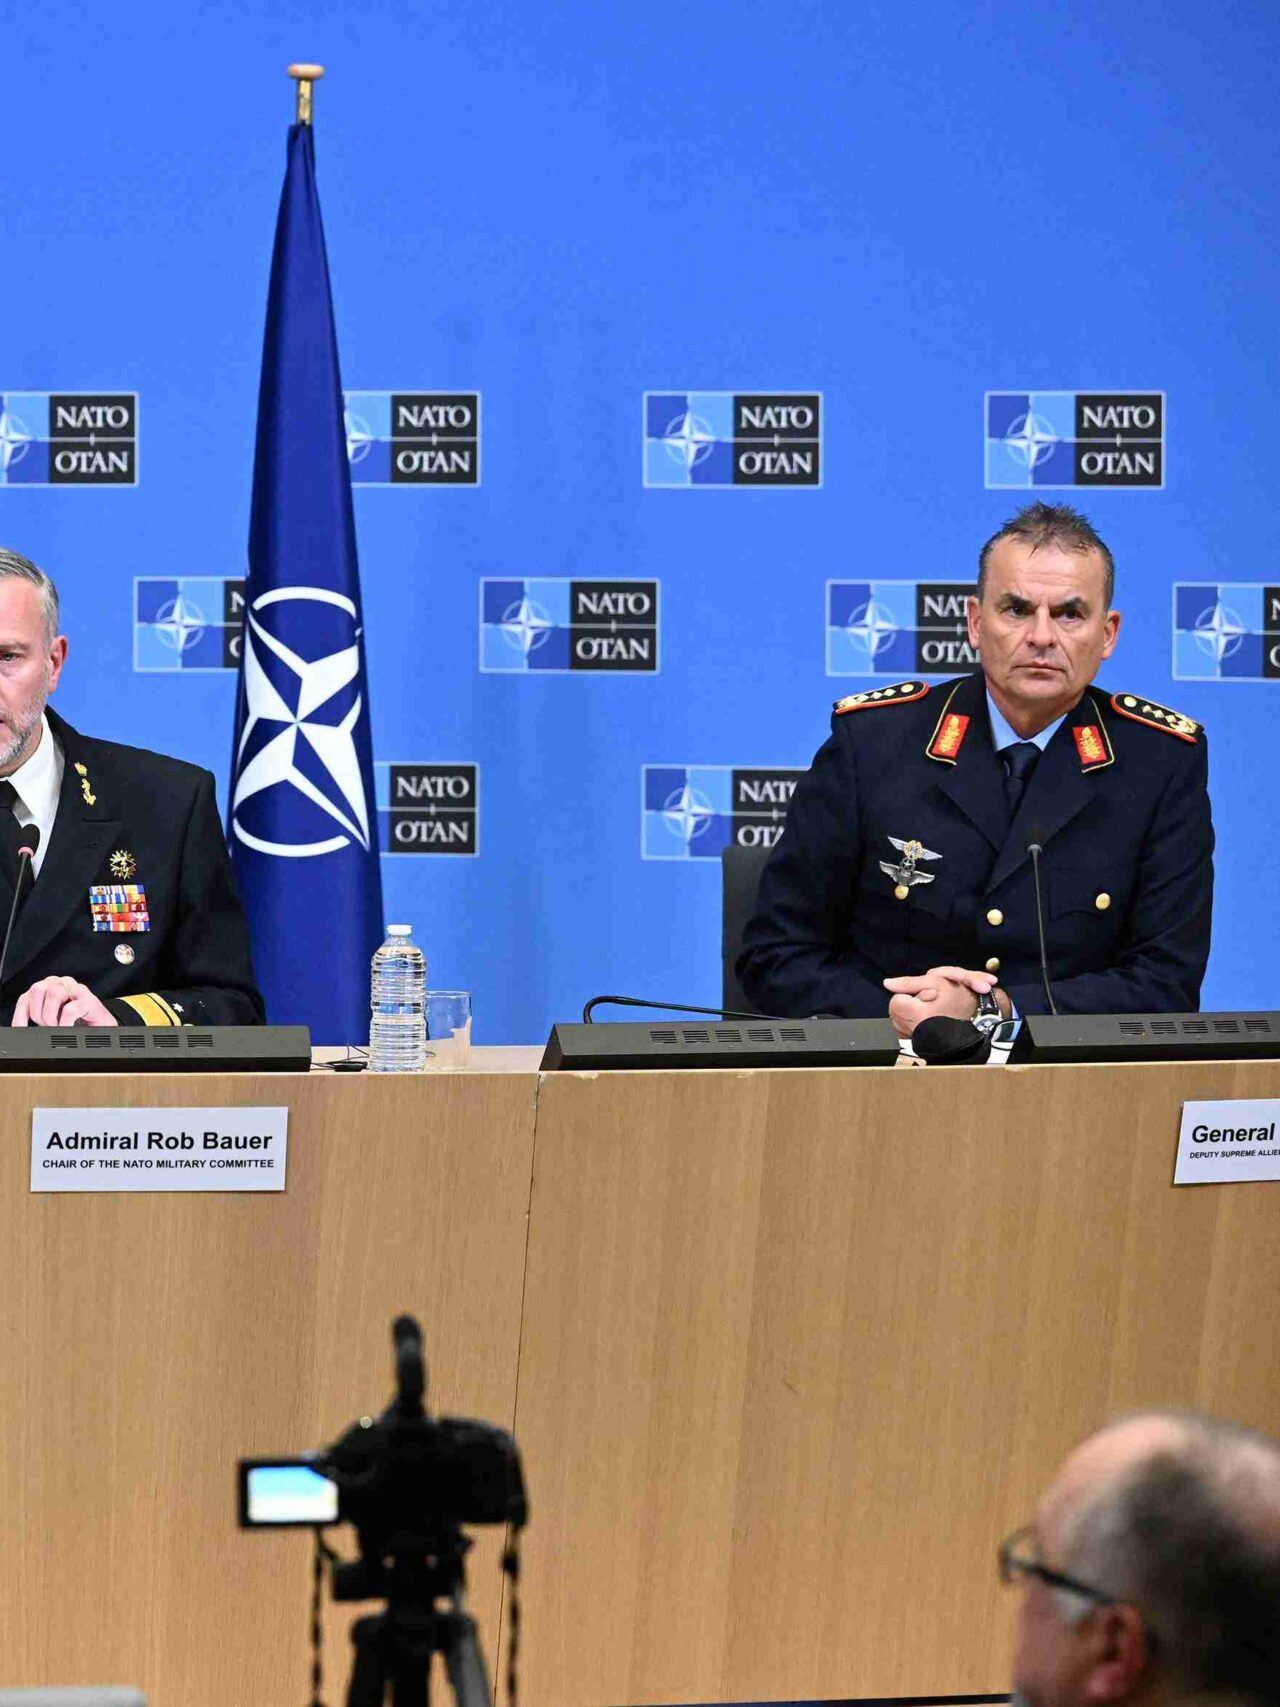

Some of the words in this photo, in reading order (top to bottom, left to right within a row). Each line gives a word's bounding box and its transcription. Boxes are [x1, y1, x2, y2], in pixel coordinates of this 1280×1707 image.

[56, 406, 129, 428] NATO
[398, 406, 471, 428] NATO
[740, 406, 813, 428] NATO
[1082, 406, 1155, 429] NATO
[55, 451, 128, 473] OTAN
[397, 451, 470, 474] OTAN
[739, 452, 812, 475] OTAN
[1081, 452, 1154, 475] OTAN
[577, 592, 650, 615] NATO
[923, 594, 968, 617] NAT
[576, 637, 649, 660] OTAN
[921, 640, 981, 663] OTA
[397, 776, 469, 798] NATO
[395, 820, 468, 842] OTAN
[46, 1131, 139, 1150] Admiral
[147, 1131, 195, 1150] Rob
[202, 1131, 273, 1150] Bauer
[1191, 1122, 1276, 1144] General
[42, 1159, 77, 1169] CHAIR
[80, 1159, 95, 1169] OF
[99, 1159, 120, 1168] THE
[123, 1159, 153, 1169] NATO
[156, 1159, 207, 1168] MILITARY
[209, 1159, 275, 1168] COMMITTEE
[1189, 1151, 1219, 1159] DEPUTY
[1220, 1149, 1256, 1158] SUPREME
[1256, 1148, 1280, 1156] ALLIE
